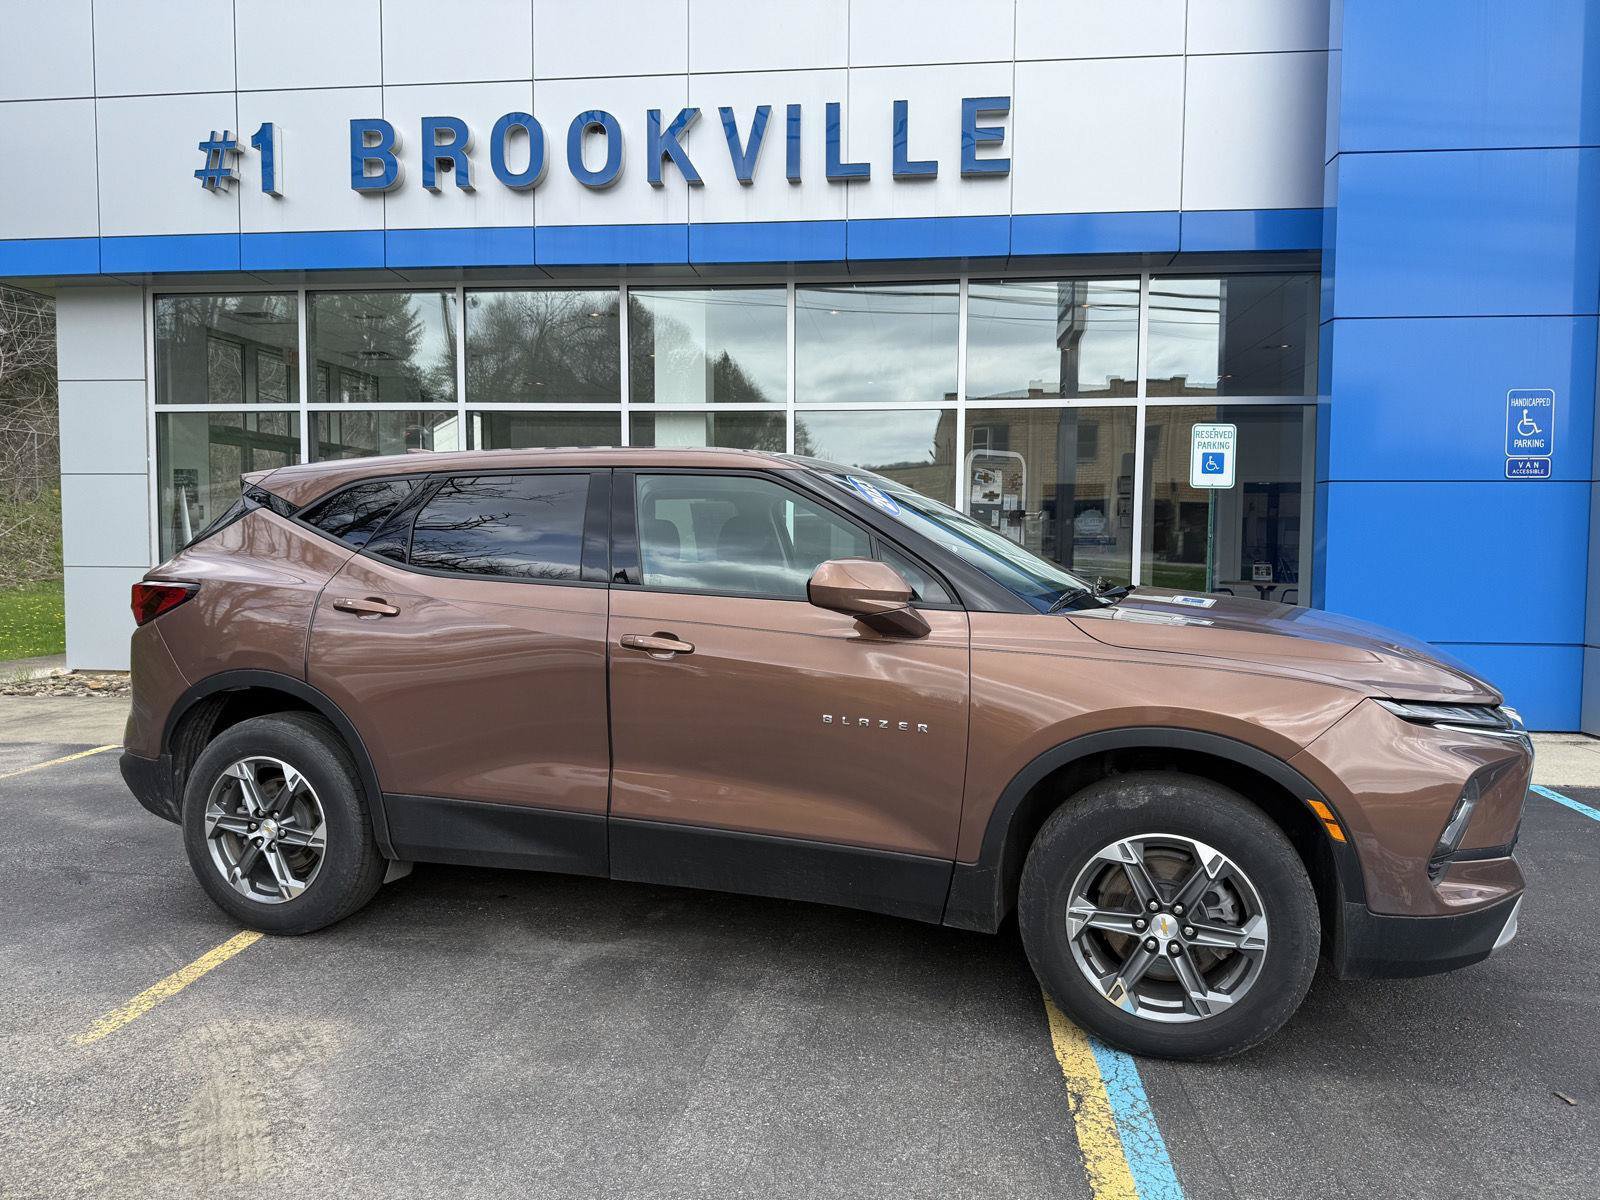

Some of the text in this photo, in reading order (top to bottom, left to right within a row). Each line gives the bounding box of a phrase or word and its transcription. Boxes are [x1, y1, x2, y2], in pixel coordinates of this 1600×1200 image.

[194, 96, 1011, 199] #1 BROOKVILLE
[1510, 397, 1551, 407] HANDICAPPED
[1195, 430, 1233, 439] RESERVED
[1197, 441, 1230, 450] PARKING
[1513, 438, 1545, 448] PARKING
[822, 714, 928, 733] BLAZER
